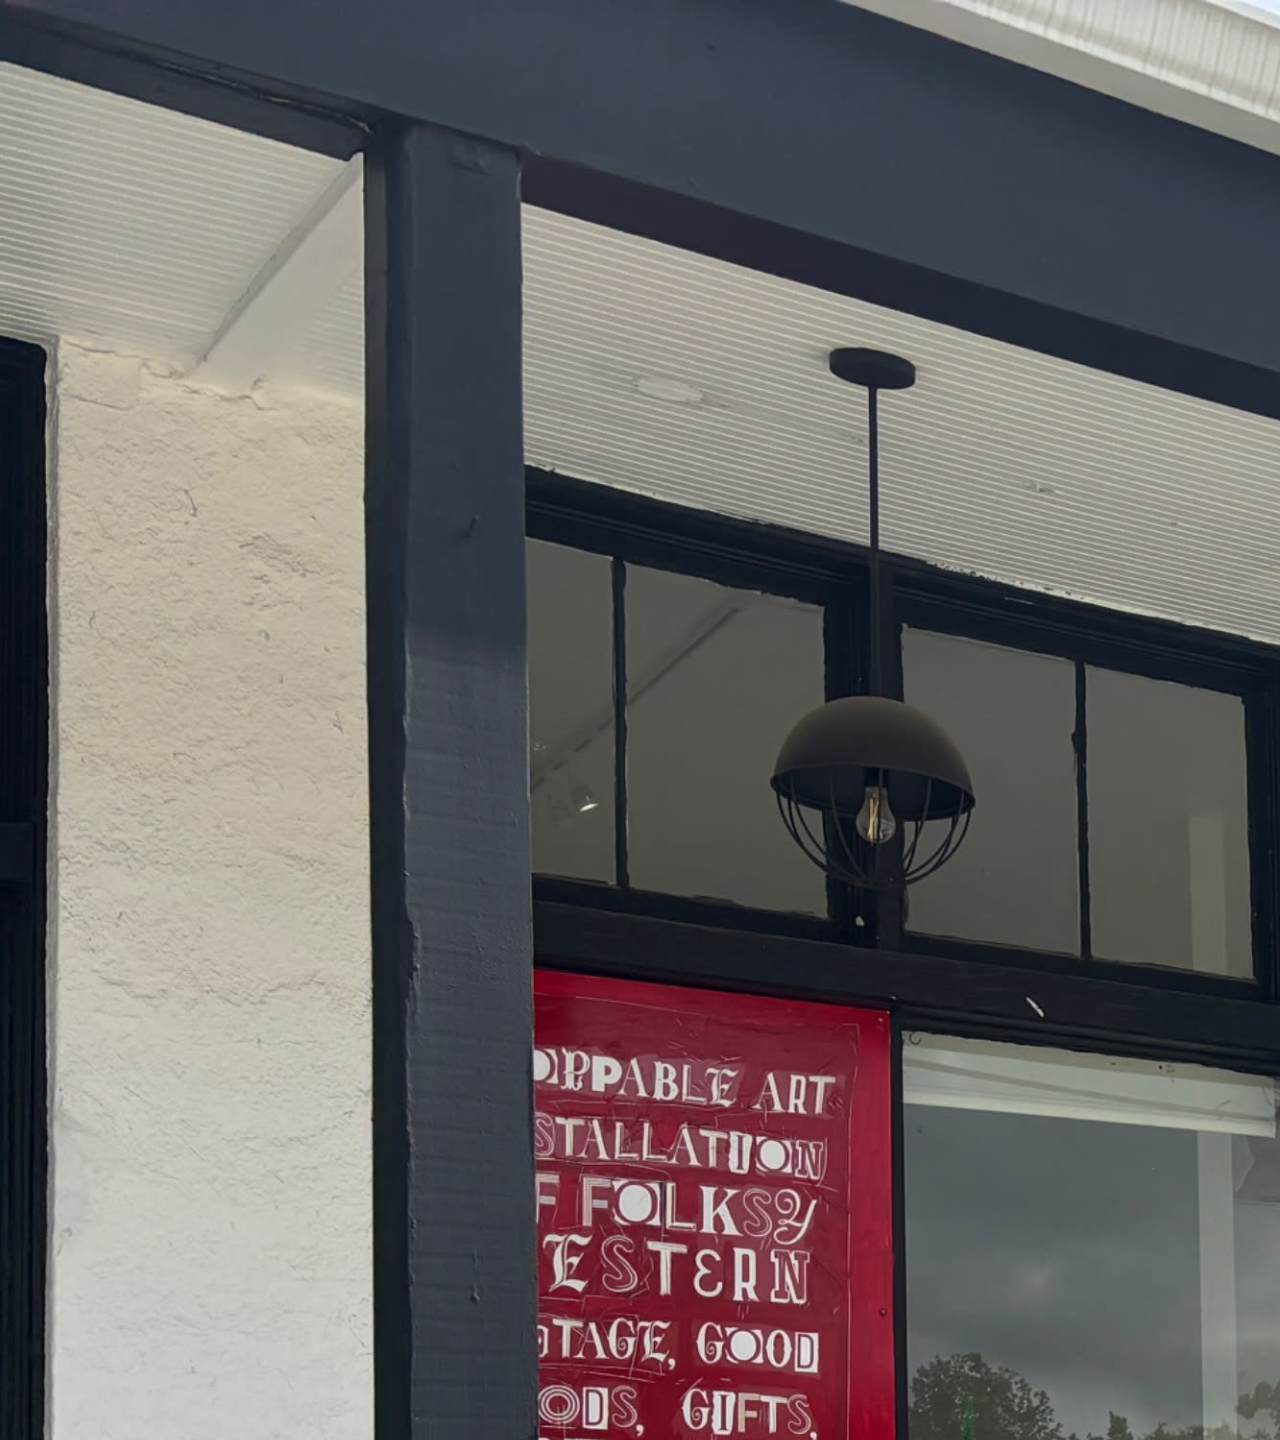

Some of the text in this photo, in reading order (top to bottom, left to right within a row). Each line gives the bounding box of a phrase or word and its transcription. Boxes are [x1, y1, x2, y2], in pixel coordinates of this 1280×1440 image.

[755, 1073, 836, 1115] ART
[582, 1177, 817, 1245] FOLKSY
[543, 1233, 811, 1304] ESTERN
[697, 1322, 819, 1373] GOOD
[538, 1384, 817, 1440] ODS, GIFTS,
